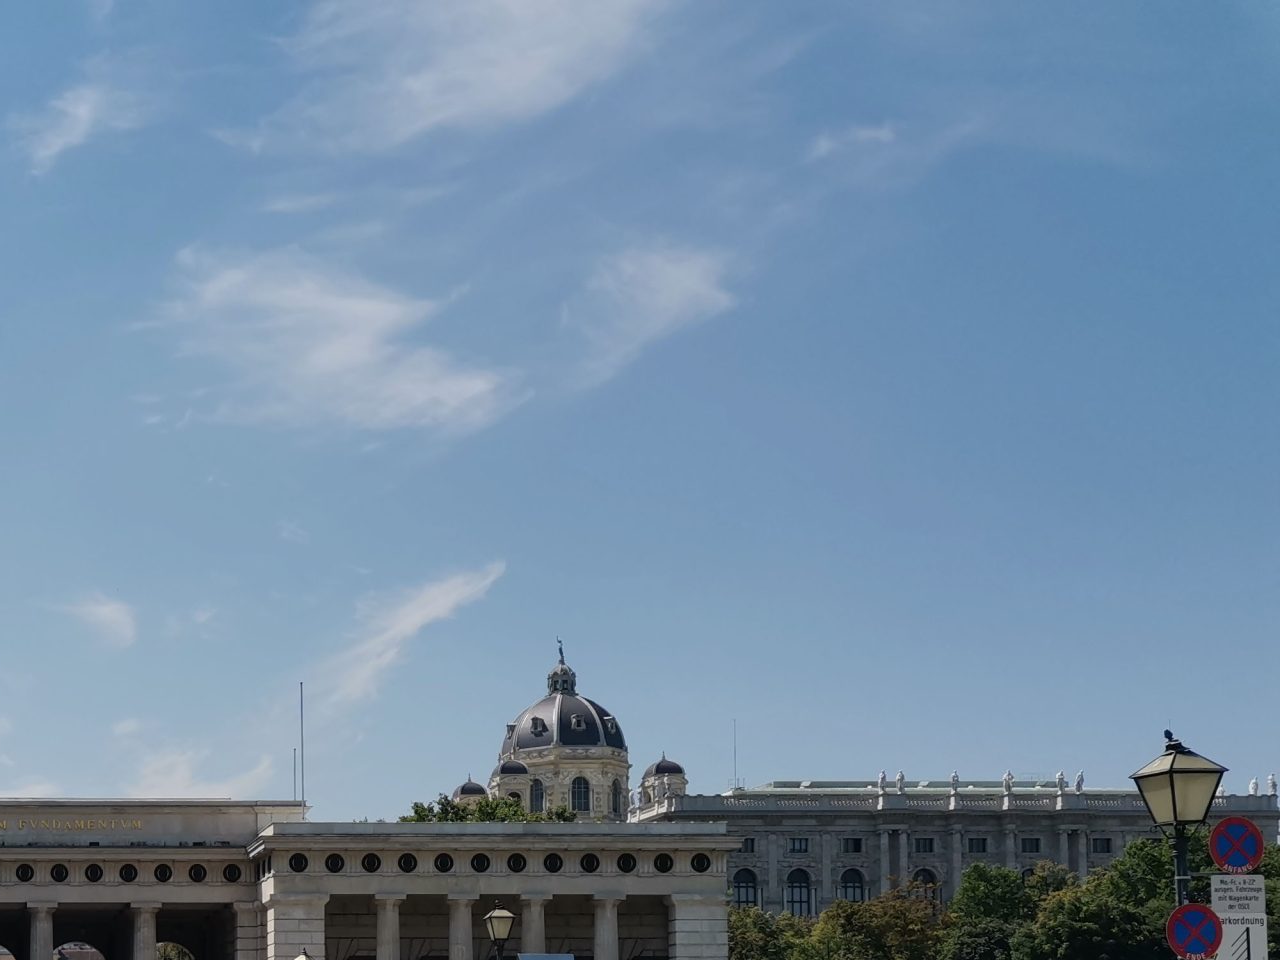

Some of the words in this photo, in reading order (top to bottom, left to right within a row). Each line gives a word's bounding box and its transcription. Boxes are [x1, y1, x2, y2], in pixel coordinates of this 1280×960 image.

[19, 818, 143, 831] FVNDAMENTVM
[1223, 863, 1253, 873] ANFANG
[1186, 952, 1206, 960] ENDE
